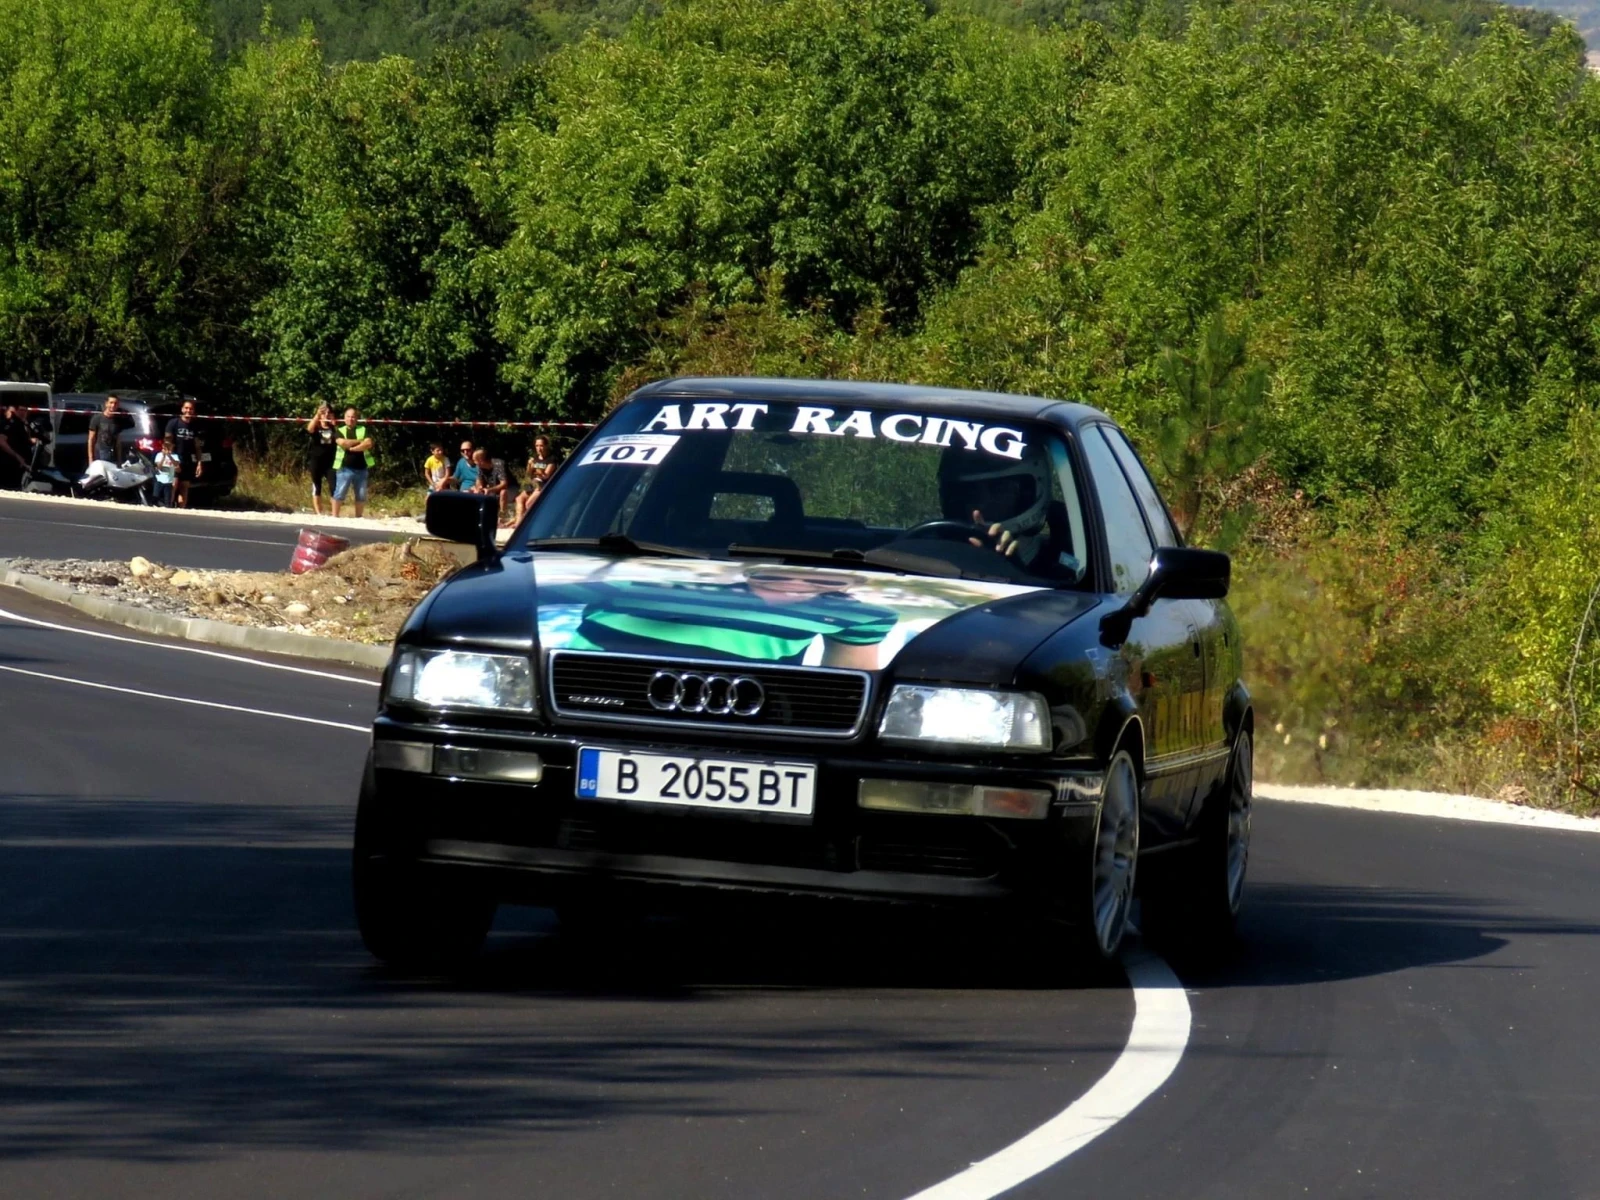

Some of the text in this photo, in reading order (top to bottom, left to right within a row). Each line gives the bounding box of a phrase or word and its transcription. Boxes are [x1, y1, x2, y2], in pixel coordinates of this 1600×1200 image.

[641, 404, 1027, 460] ART RACING
[591, 446, 657, 462] 101
[580, 779, 596, 791] BG
